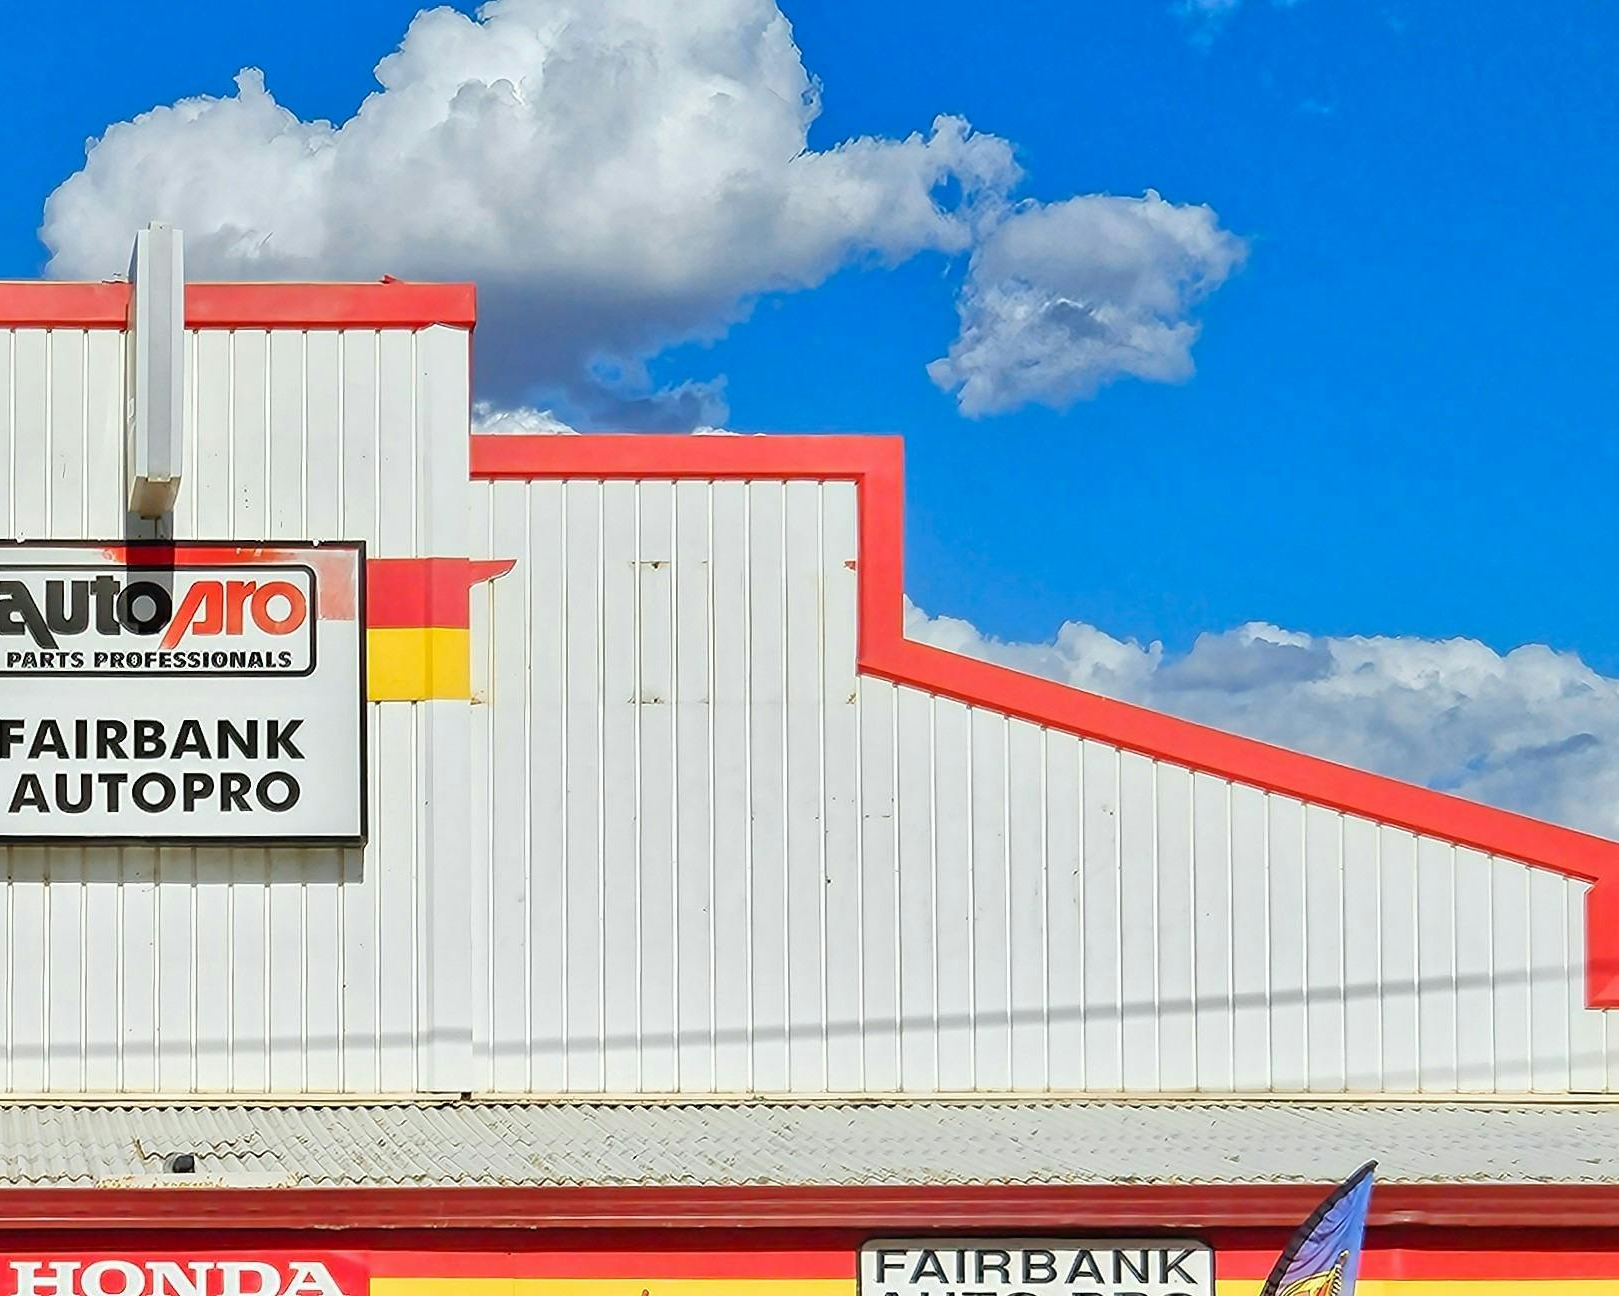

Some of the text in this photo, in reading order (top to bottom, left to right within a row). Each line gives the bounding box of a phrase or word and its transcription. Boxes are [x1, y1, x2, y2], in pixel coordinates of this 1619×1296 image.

[7, 650, 293, 669] PARTS PROFESSIONALS
[7, 771, 301, 813] AUTOPRO
[873, 1248, 1198, 1285] FAIRBANK
